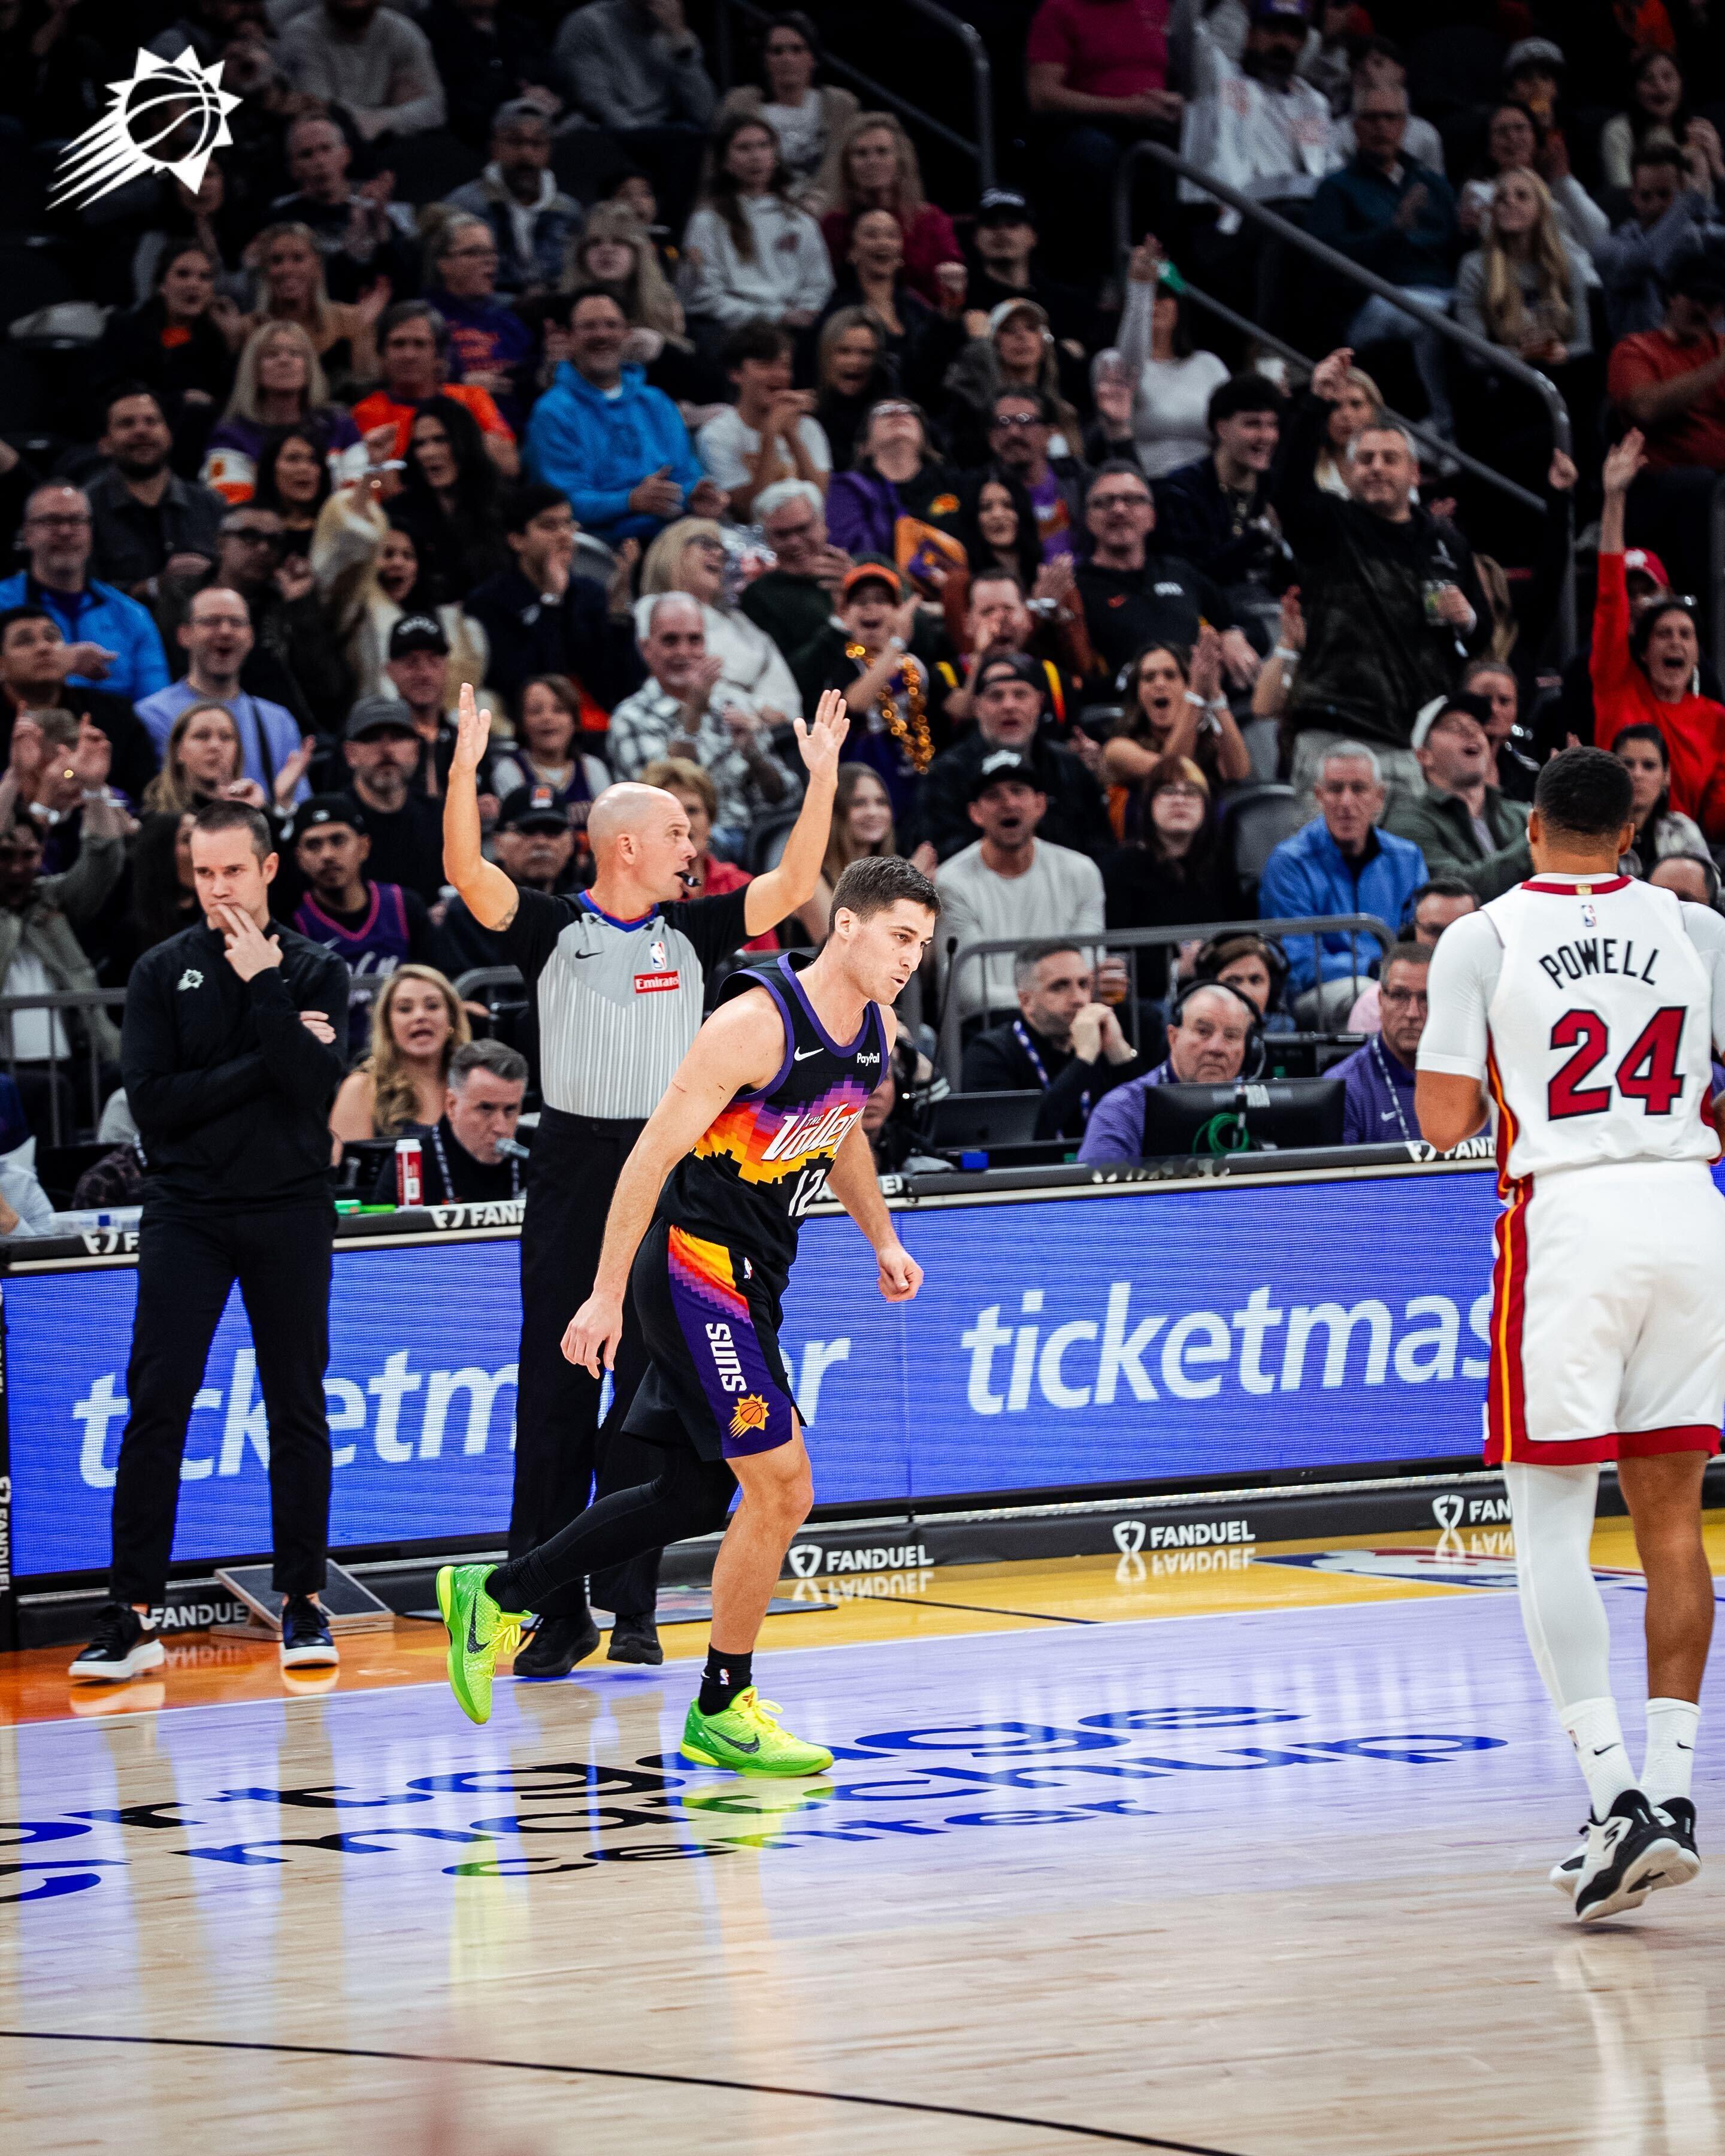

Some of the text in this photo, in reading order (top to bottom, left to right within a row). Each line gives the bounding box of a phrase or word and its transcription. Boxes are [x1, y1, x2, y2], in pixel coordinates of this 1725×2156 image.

[1539, 938, 1659, 989] POWELL
[857, 1052, 880, 1066] PayPal
[1548, 1006, 1688, 1121] 24
[806, 1114, 824, 1127] THE
[788, 1168, 826, 1216] 12
[705, 1322, 748, 1392] SUNS
[826, 1545, 935, 1572] FANDUEL
[1150, 1520, 1256, 1549] FANDUEL
[150, 1601, 249, 1629] FANDUE
[169, 1734, 1509, 1866] matchup
[441, 1799, 1165, 1877] center
